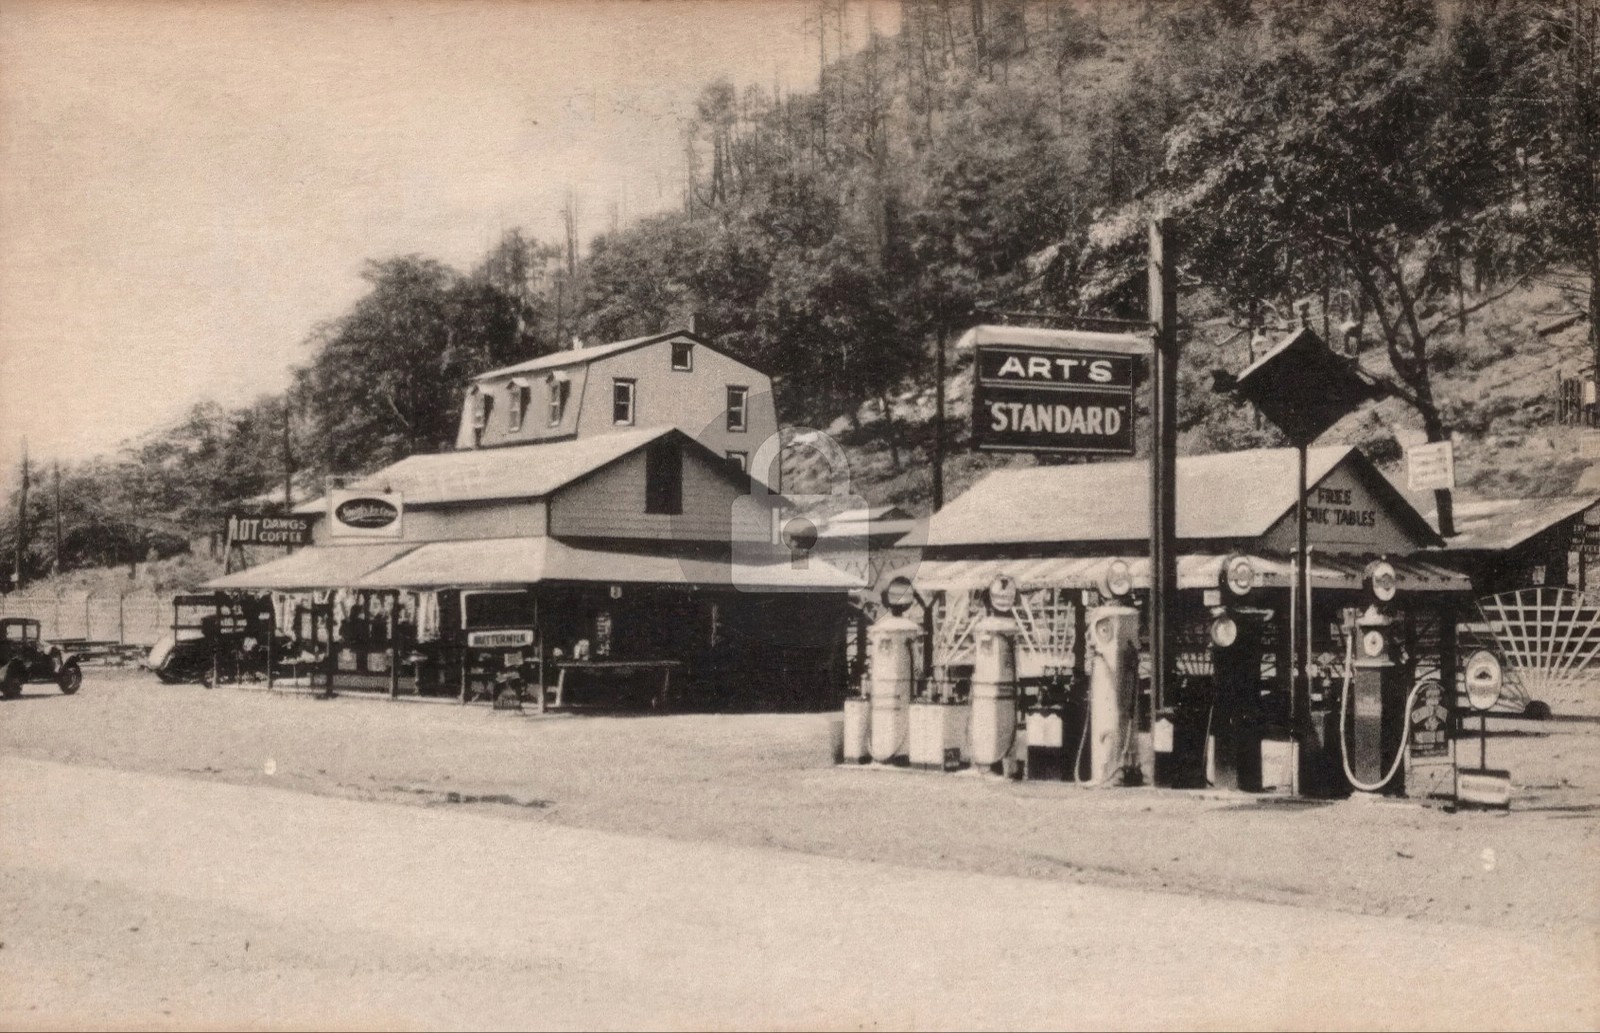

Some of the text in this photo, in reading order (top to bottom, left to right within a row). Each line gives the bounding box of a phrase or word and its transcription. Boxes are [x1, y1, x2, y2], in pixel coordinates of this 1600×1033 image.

[997, 355, 1113, 383] ART'S
[1318, 488, 1351, 506] FREE
[1334, 508, 1375, 527] TABLES
[259, 531, 303, 543] COFFEE
